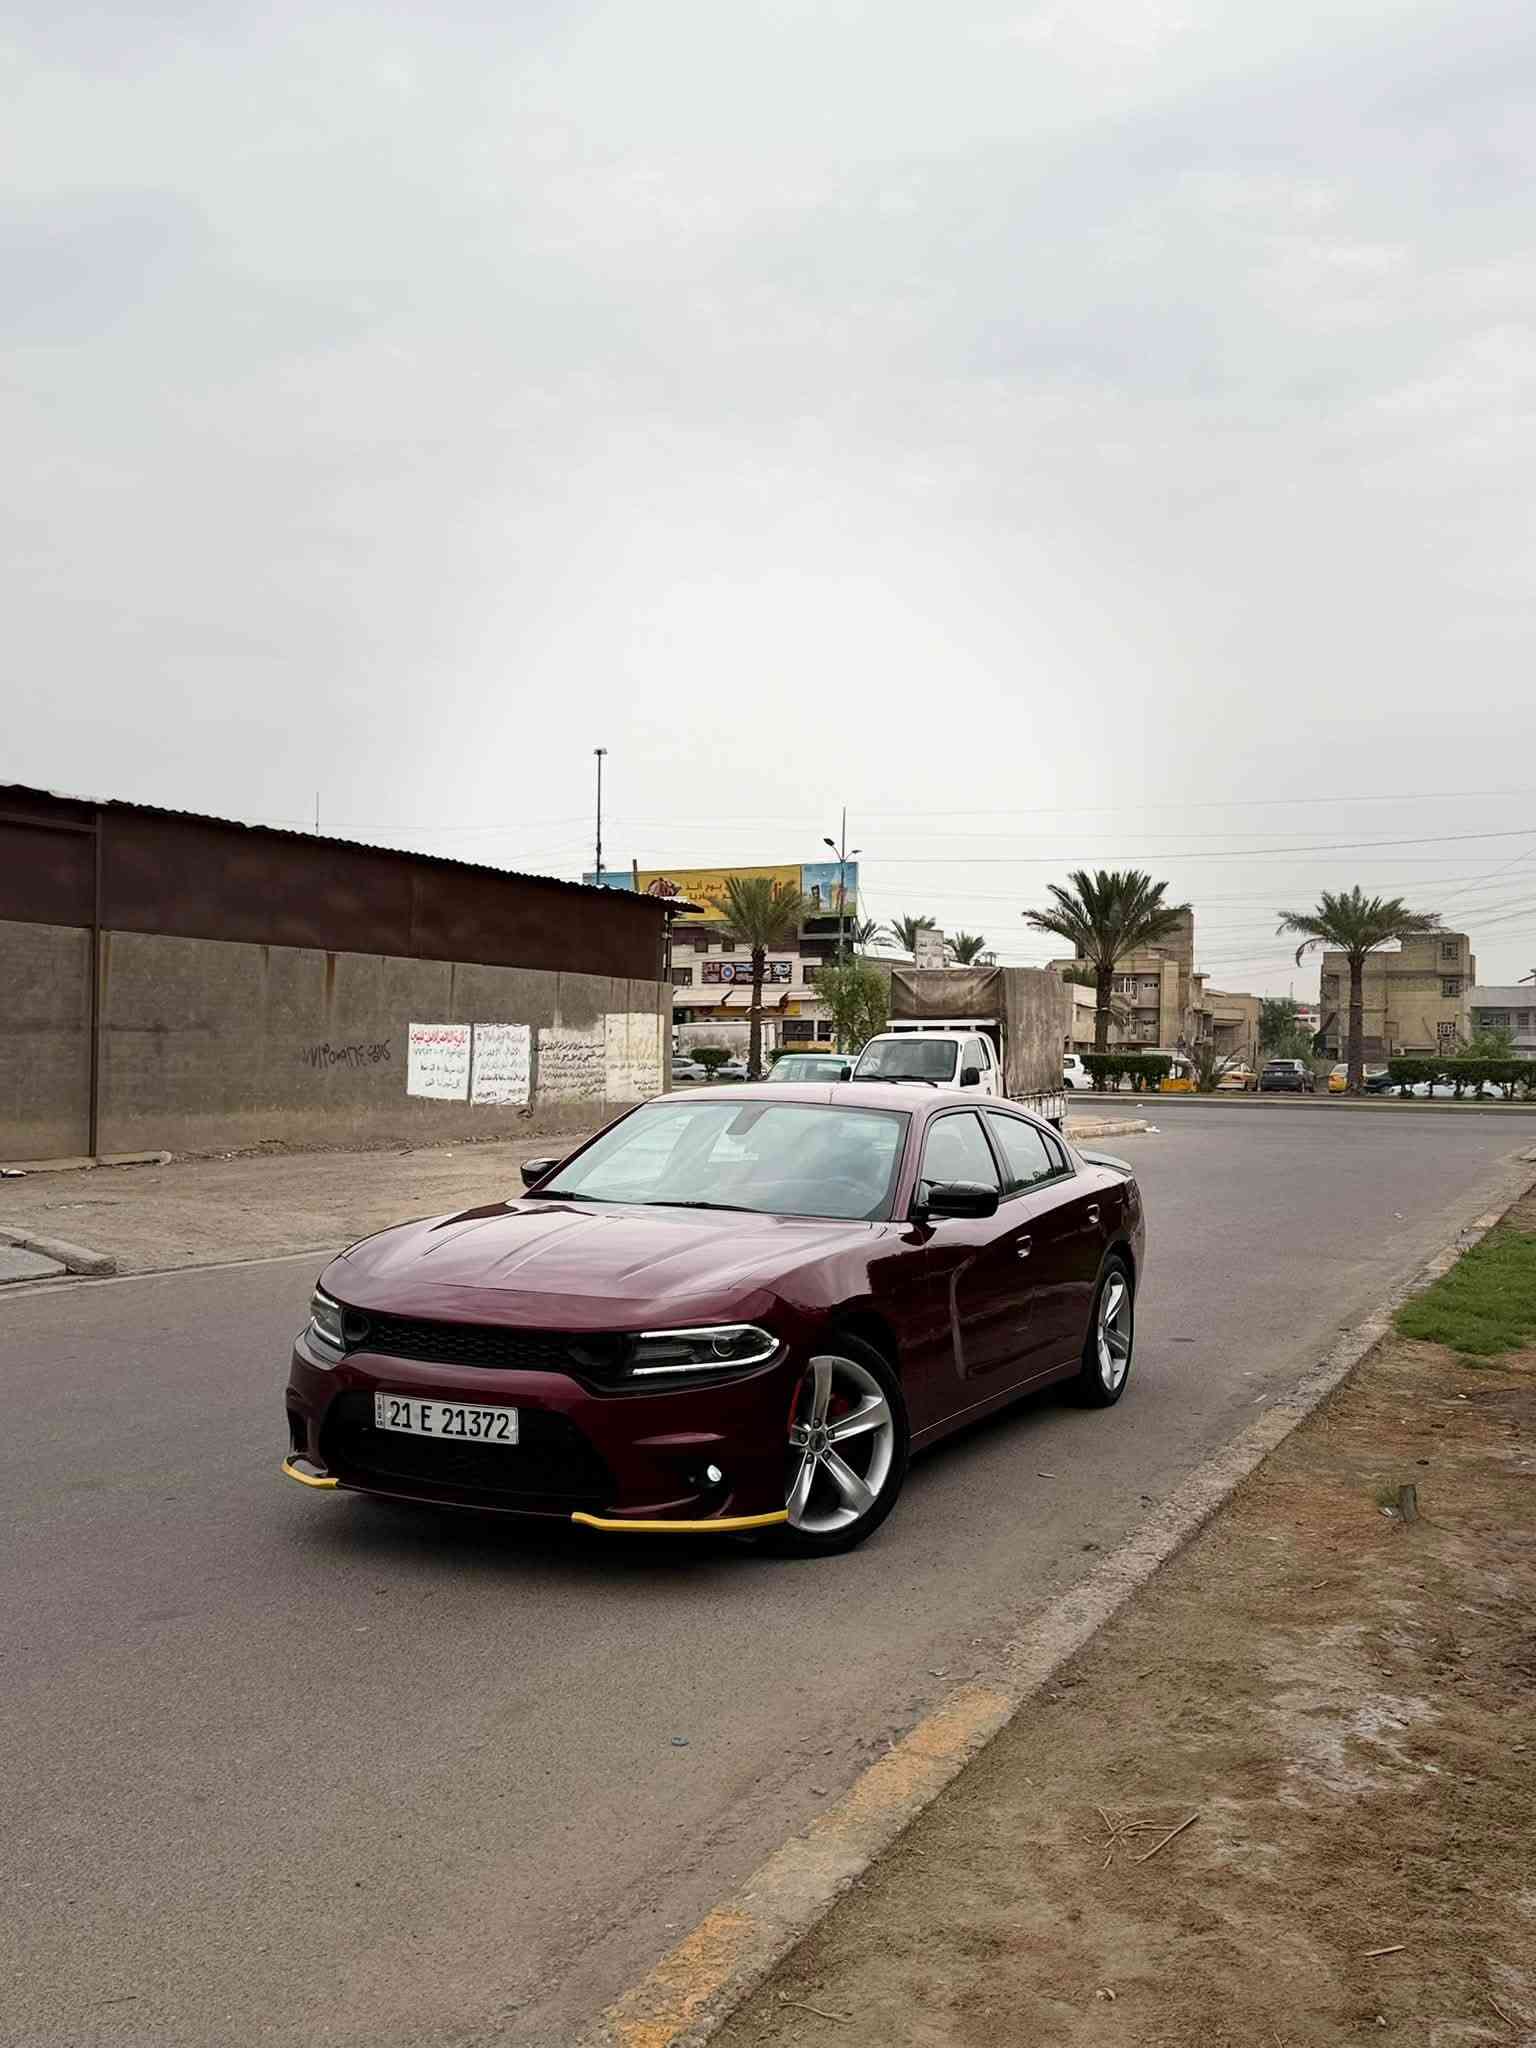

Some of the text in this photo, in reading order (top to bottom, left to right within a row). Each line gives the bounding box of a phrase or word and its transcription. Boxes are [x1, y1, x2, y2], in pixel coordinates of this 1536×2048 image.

[390, 1401, 412, 1429] 21
[421, 1405, 432, 1431] E
[441, 1408, 510, 1440] 21372
